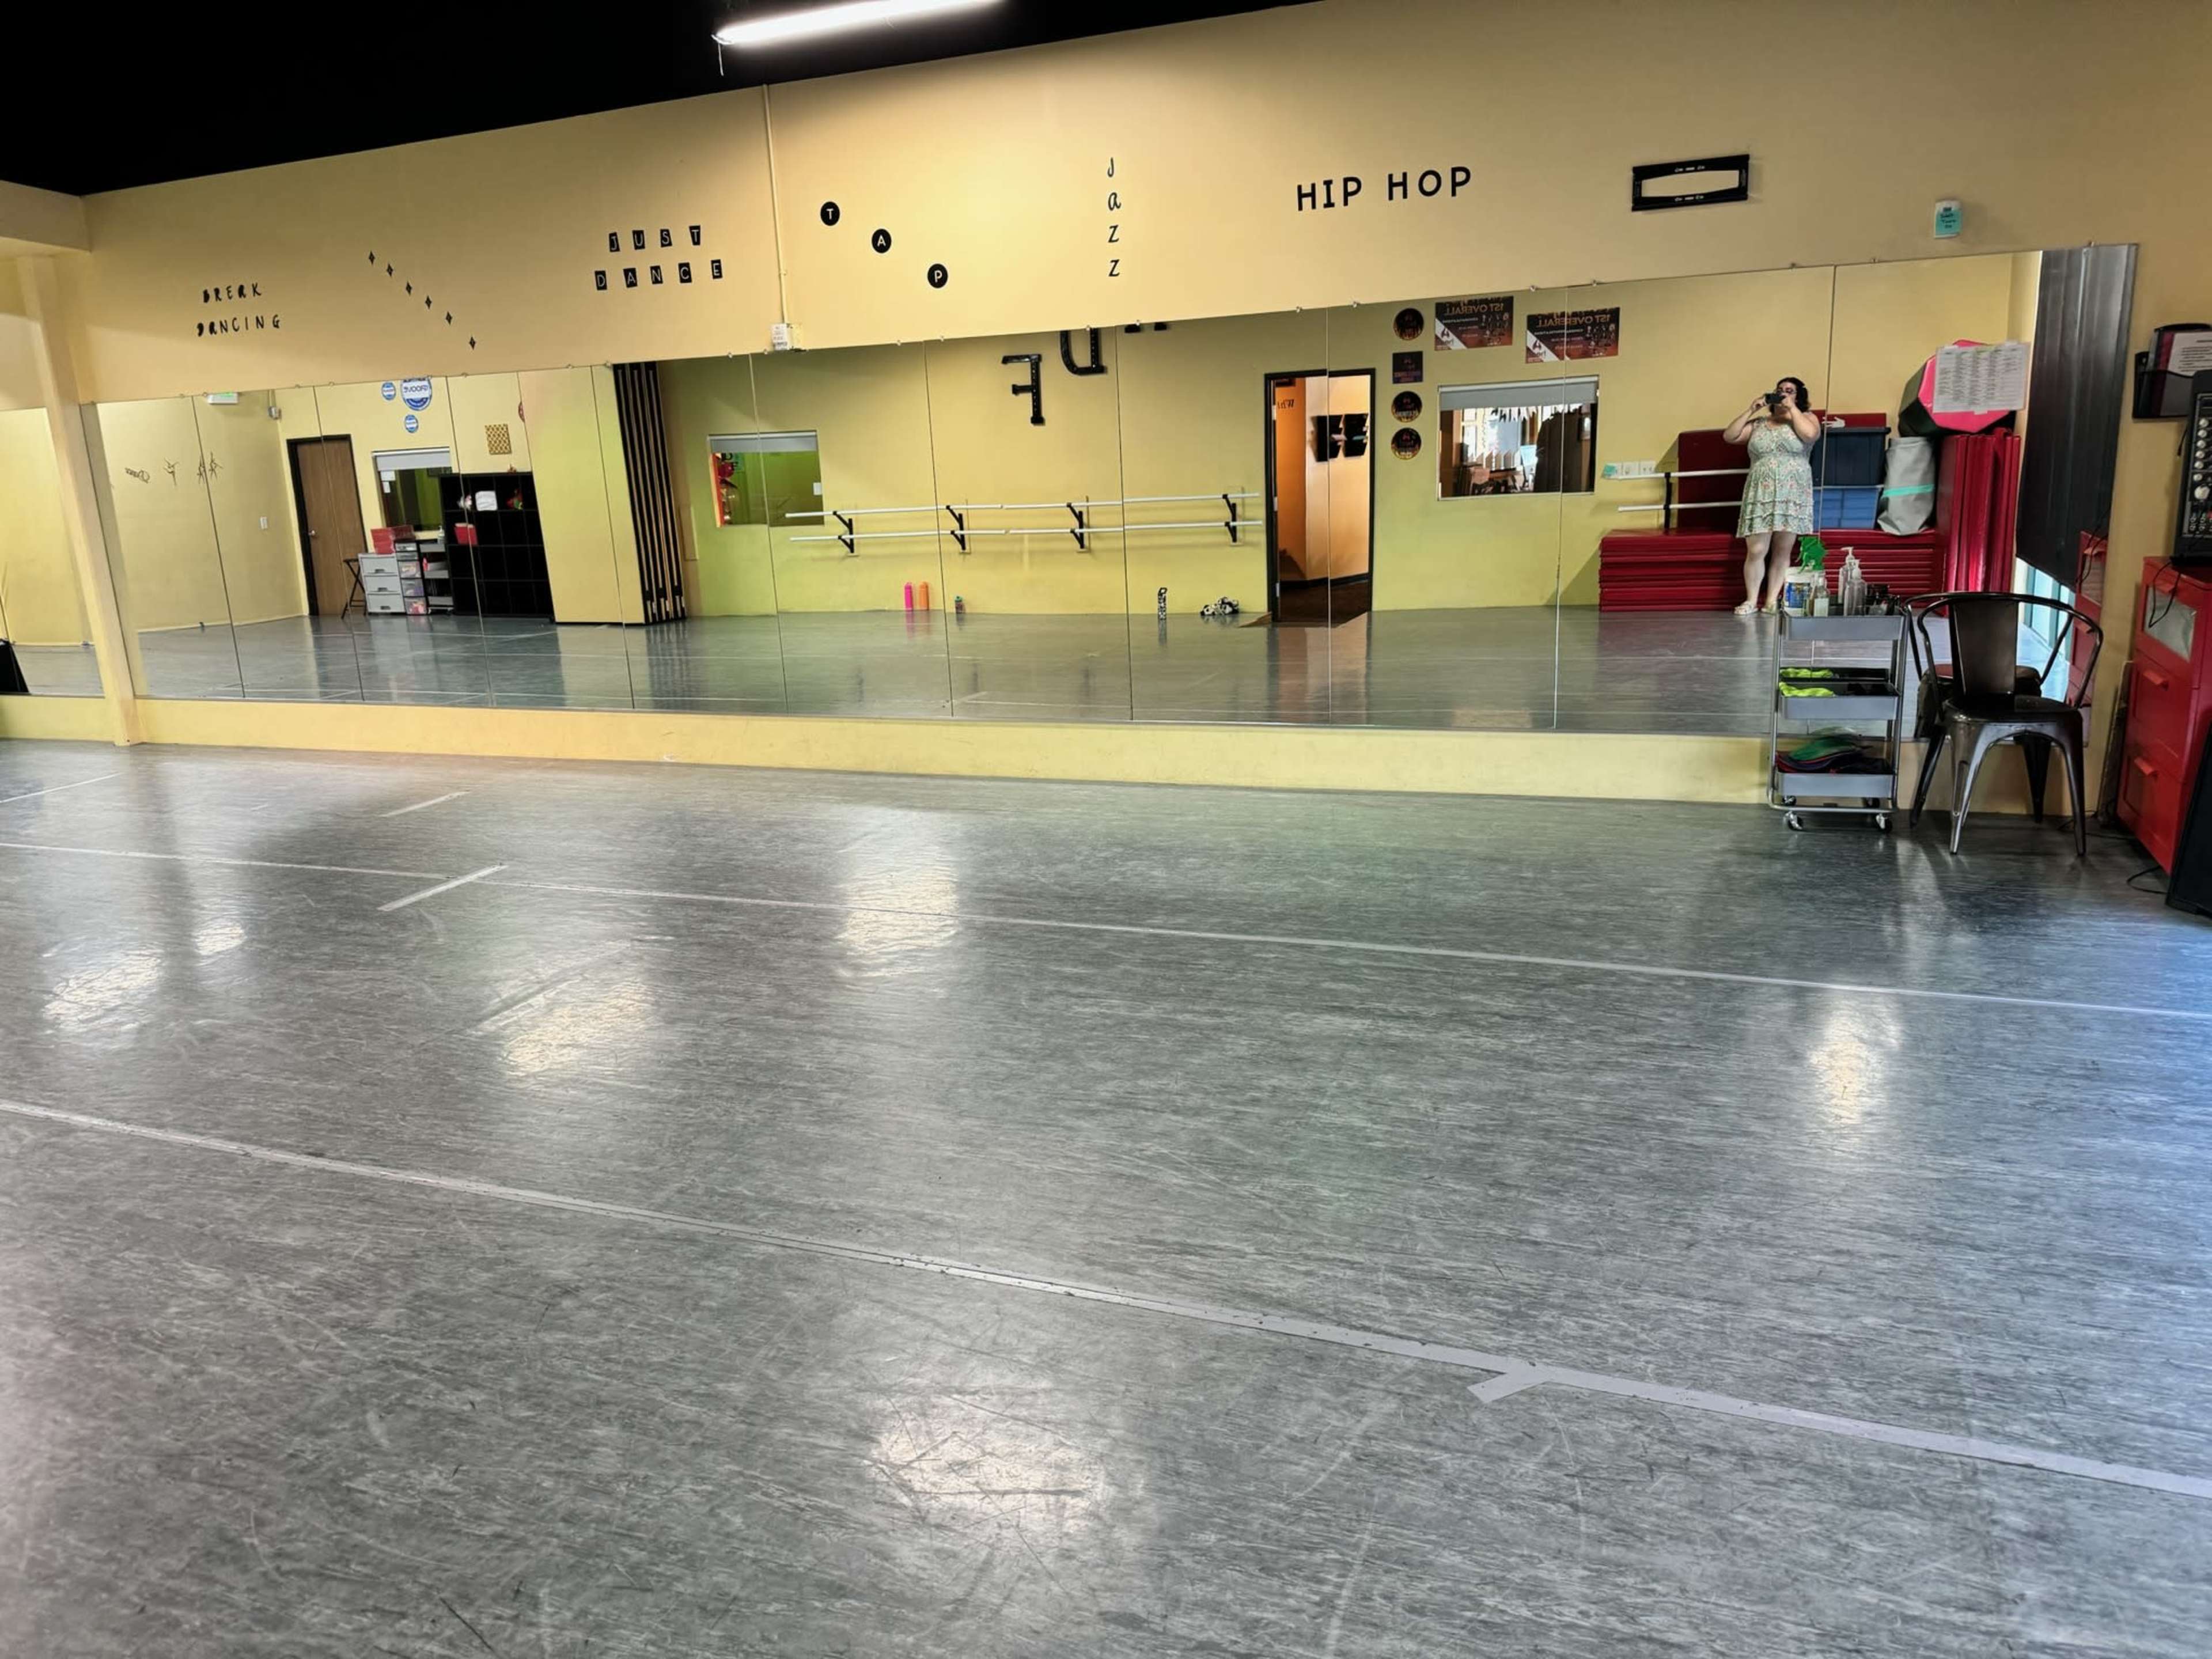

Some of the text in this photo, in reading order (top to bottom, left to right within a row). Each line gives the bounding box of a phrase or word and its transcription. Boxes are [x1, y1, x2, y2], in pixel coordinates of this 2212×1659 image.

[1297, 166, 1471, 211] HIP HOP
[609, 228, 700, 251] JUST
[596, 261, 721, 289] DANCE
[203, 282, 262, 304] BREAK
[196, 314, 281, 337] DANCING
